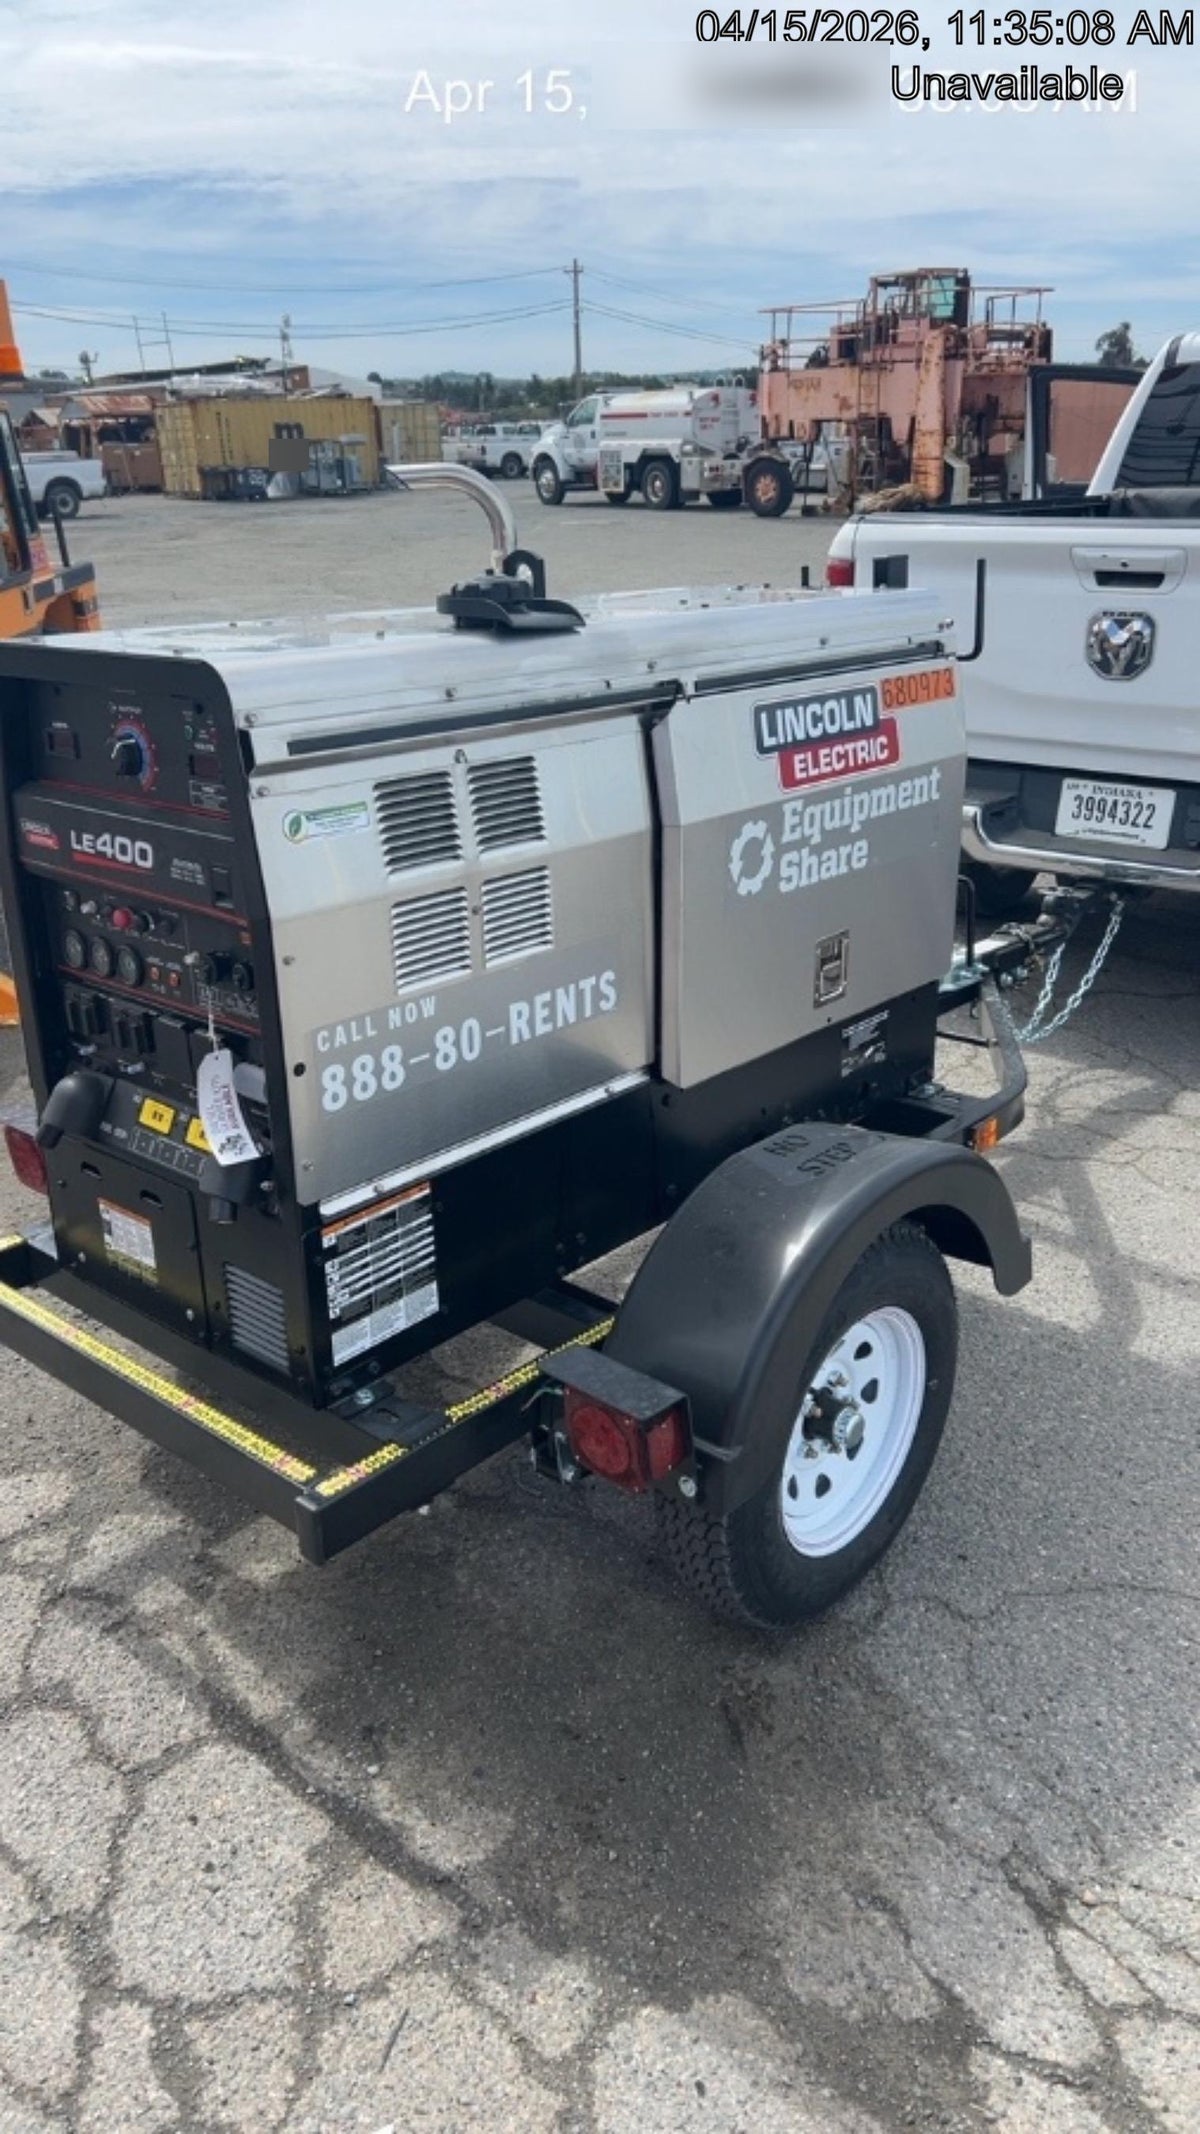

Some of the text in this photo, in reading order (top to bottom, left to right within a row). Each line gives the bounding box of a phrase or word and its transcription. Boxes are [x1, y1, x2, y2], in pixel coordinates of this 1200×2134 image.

[883, 668, 954, 708] 680973
[759, 692, 875, 748] LINCOLN
[793, 735, 889, 780] ELECTRIC
[781, 766, 942, 845] Equipment
[1071, 794, 1156, 829] 3994322
[70, 829, 154, 869] LE400
[779, 838, 869, 893] Share
[316, 996, 437, 1052] CALL NOW
[321, 969, 618, 1113] 888-80-RENTS
[762, 1134, 810, 1158] NO
[796, 1142, 857, 1176] STEP
